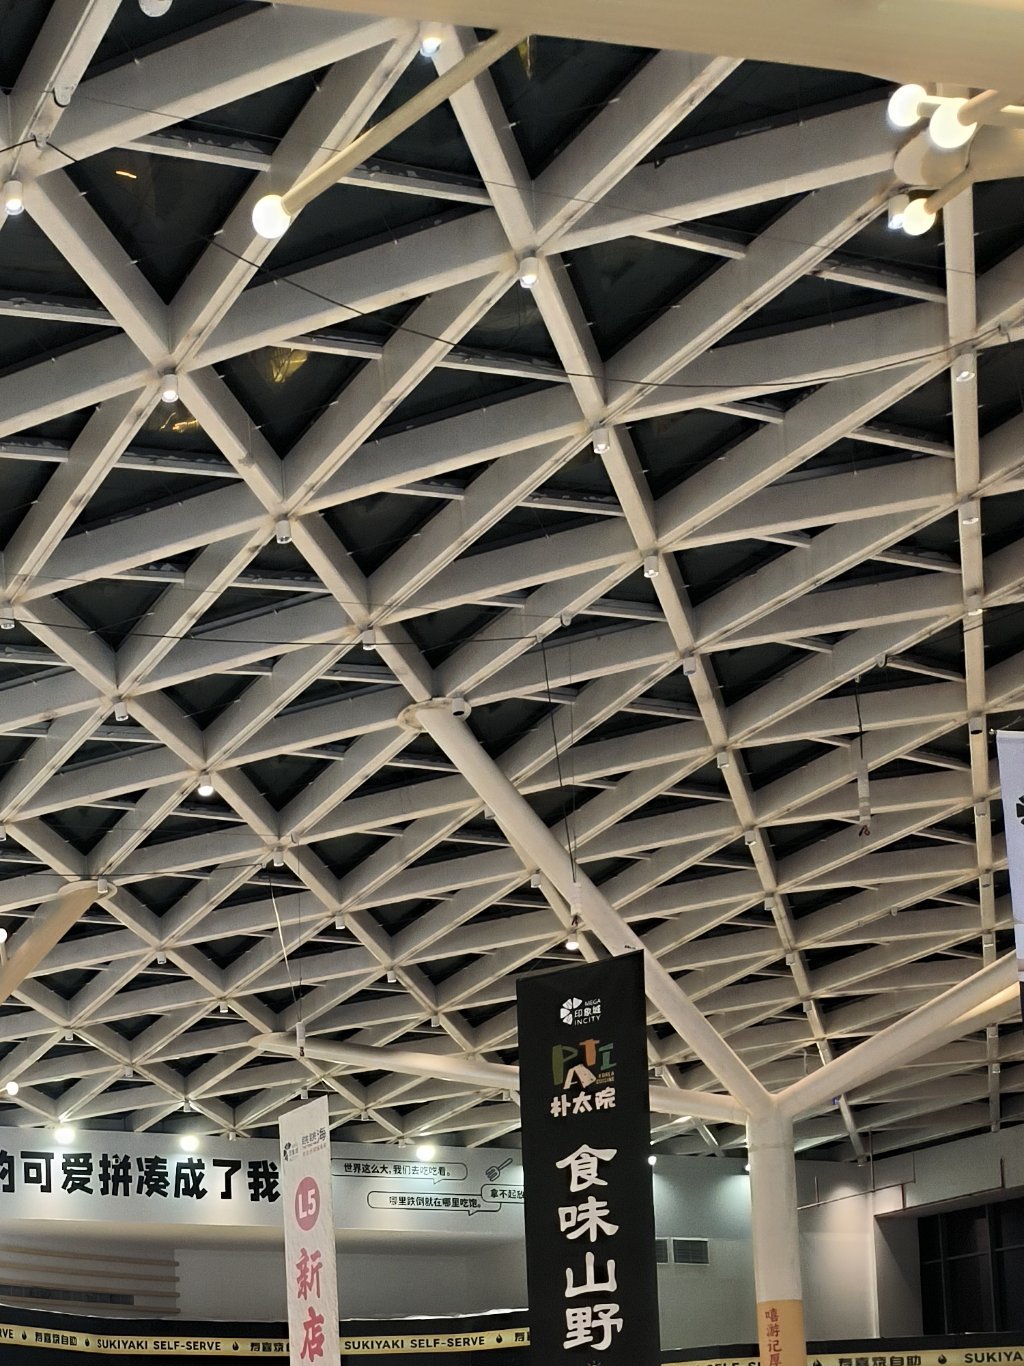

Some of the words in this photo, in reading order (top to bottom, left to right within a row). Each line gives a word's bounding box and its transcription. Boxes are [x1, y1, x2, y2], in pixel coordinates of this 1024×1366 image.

[574, 1015, 602, 1026] INCITY
[550, 1086, 616, 1118] 朴太院
[298, 1188, 317, 1219] L5
[97, 1338, 148, 1351] SUKIYAKI
[153, 1340, 222, 1352] SELF-SERVE
[344, 1339, 405, 1351] SUKIYAKI
[410, 1335, 486, 1349] SELF-SERVE
